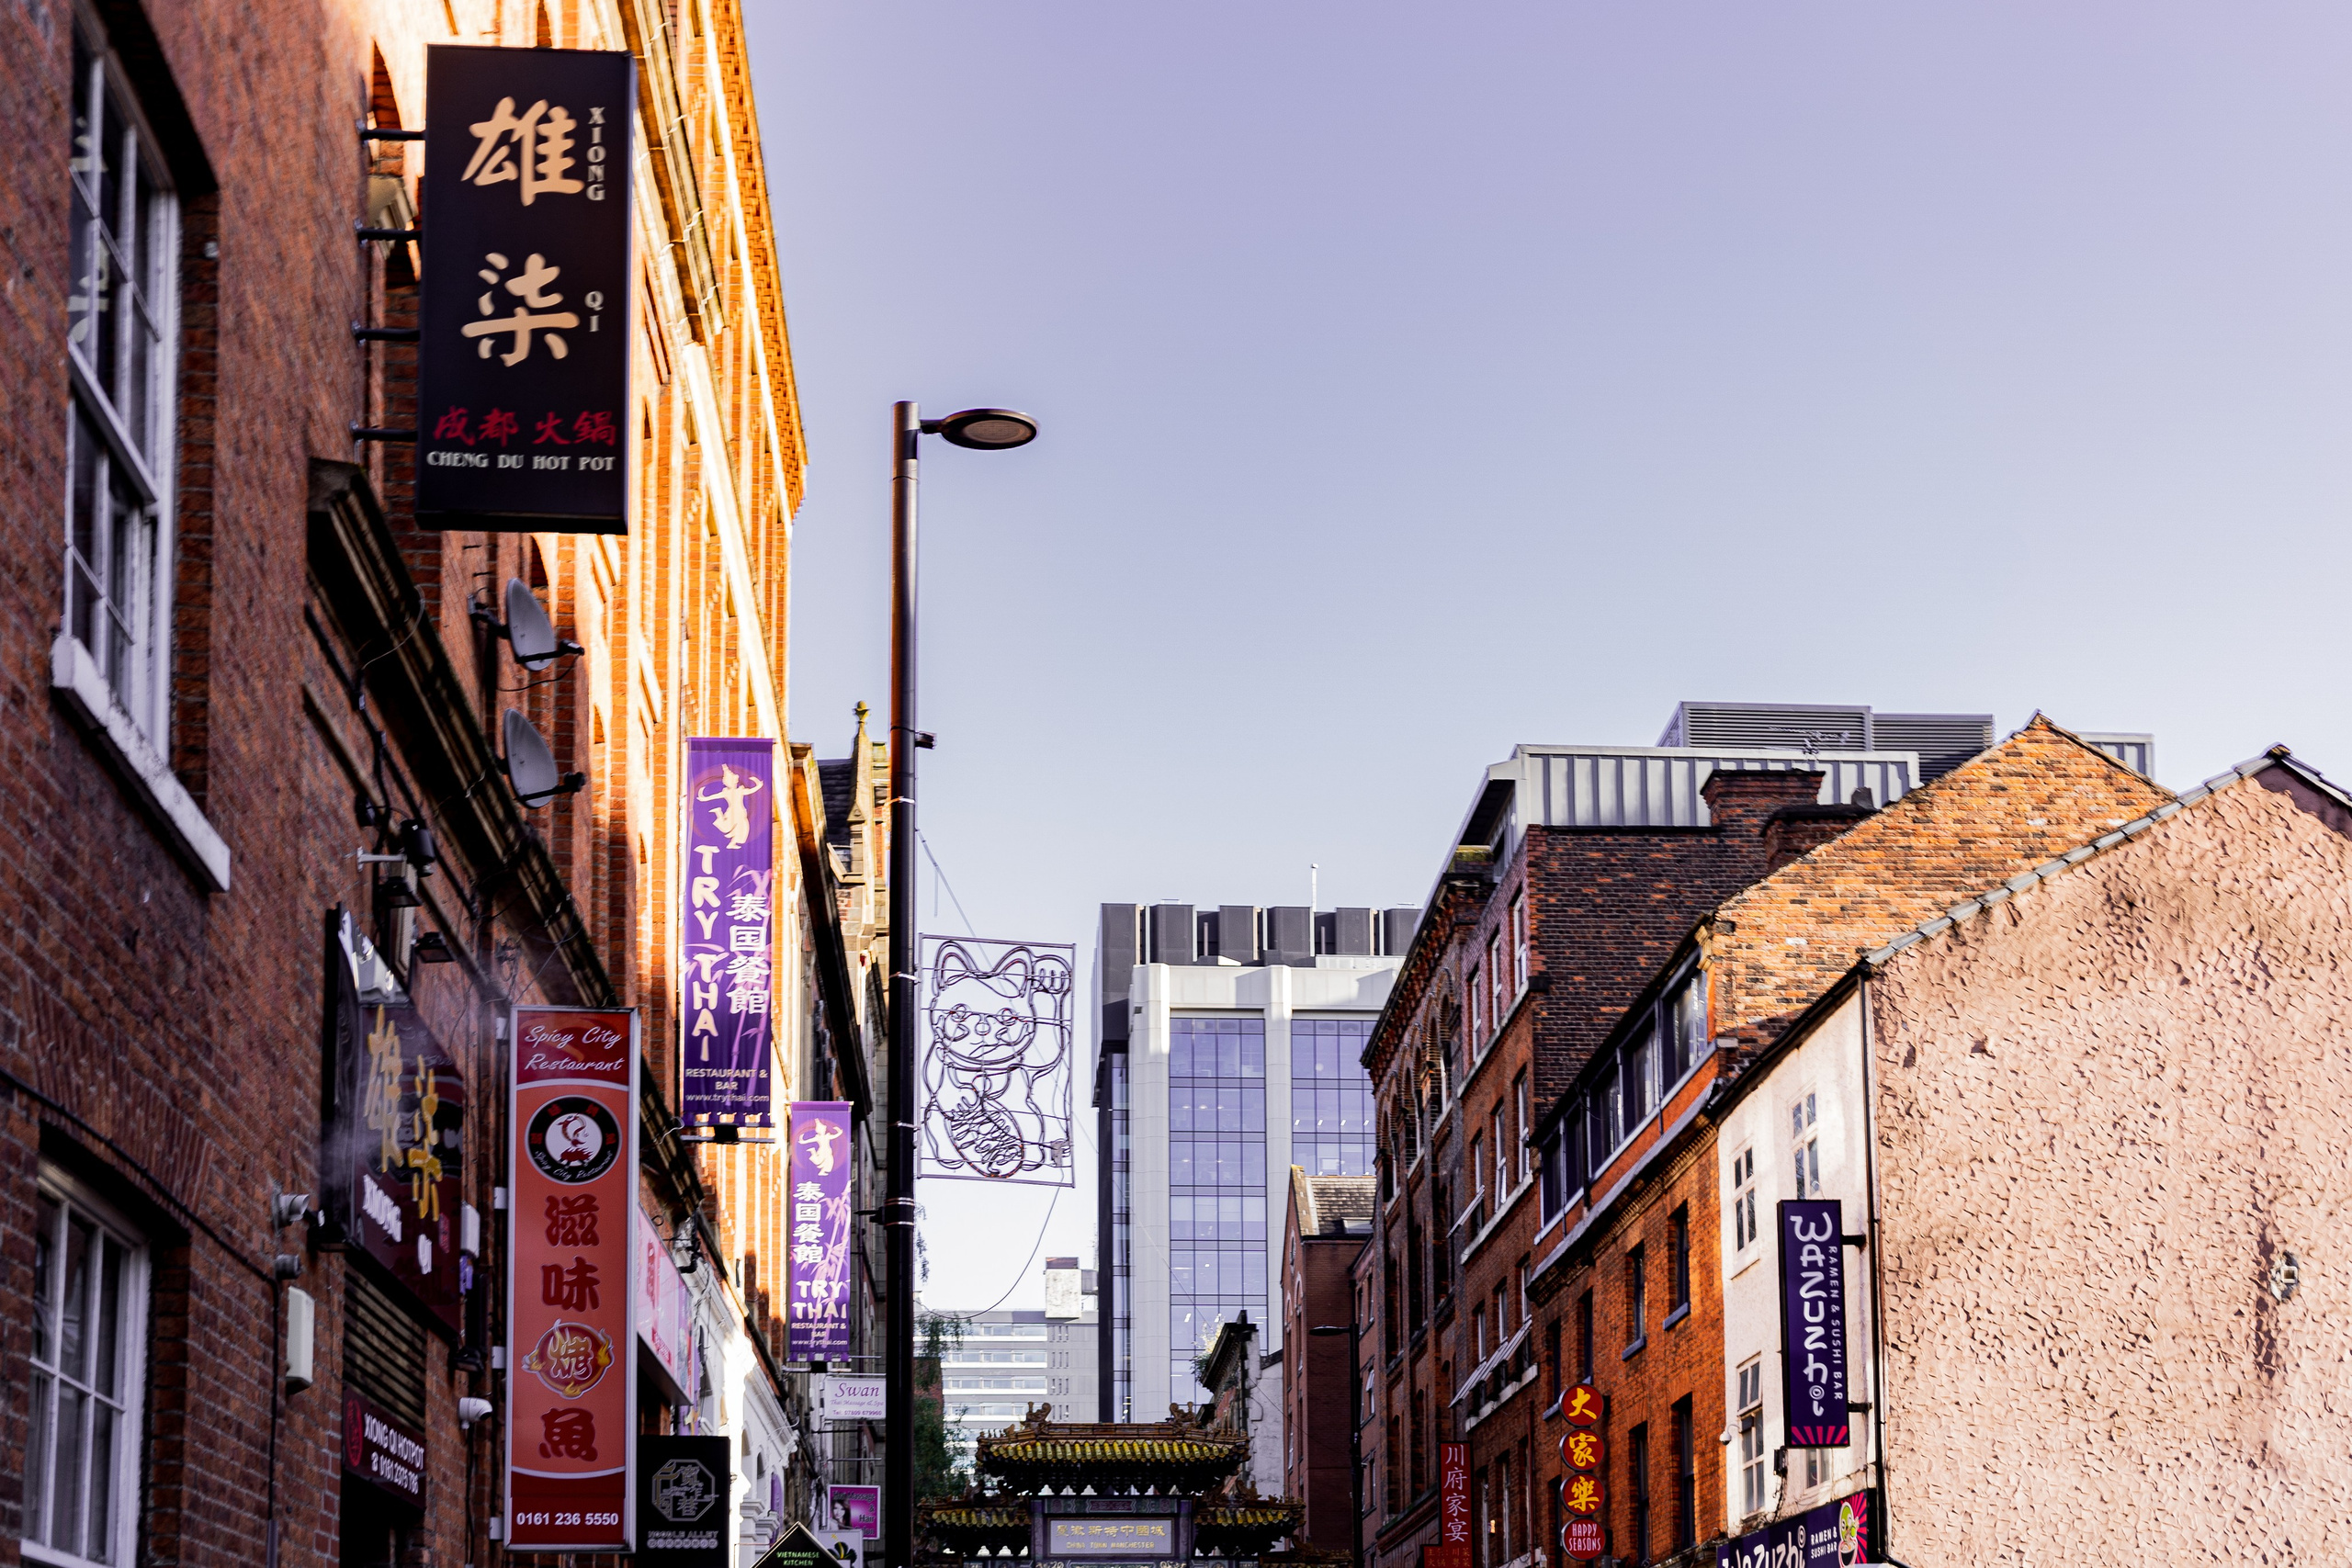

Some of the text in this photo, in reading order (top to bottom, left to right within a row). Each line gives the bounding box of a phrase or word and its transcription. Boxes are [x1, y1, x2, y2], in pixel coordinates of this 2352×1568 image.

[584, 107, 606, 333] XIONG QI
[433, 406, 616, 447] 成都 火鍋
[426, 451, 616, 470] CHENG DU HOT POT
[691, 845, 722, 1062] TRY THAI
[725, 893, 771, 1014] 泰国餐館
[525, 1025, 623, 1049] Spicy City
[524, 1053, 625, 1071] Restaurant
[685, 1068, 768, 1078] RESTAURANT &
[715, 1081, 739, 1090] BAR
[685, 1093, 770, 1103] www.trythai.com
[553, 1168, 572, 1181] City
[793, 1181, 825, 1265] 泰国餐館
[796, 1280, 843, 1298] TRY
[792, 1302, 847, 1319] THAI
[1828, 1247, 1843, 1400] RAMEN & SUSHI BAR
[834, 1382, 879, 1397] Swan
[364, 1413, 389, 1450] XIONG
[1567, 1387, 1600, 1512] 大家樂
[1443, 1444, 1468, 1542] 川府家宴
[516, 1513, 619, 1526] 0161 236 5550
[859, 1514, 875, 1523] Hair
[687, 1530, 718, 1539] ALLEY
[1572, 1524, 1597, 1537] HAPPY
[1811, 1529, 1831, 1546] RAMEN
[1568, 1538, 1601, 1551] SEASONS
[1811, 1541, 1838, 1560] SUSHI BAR
